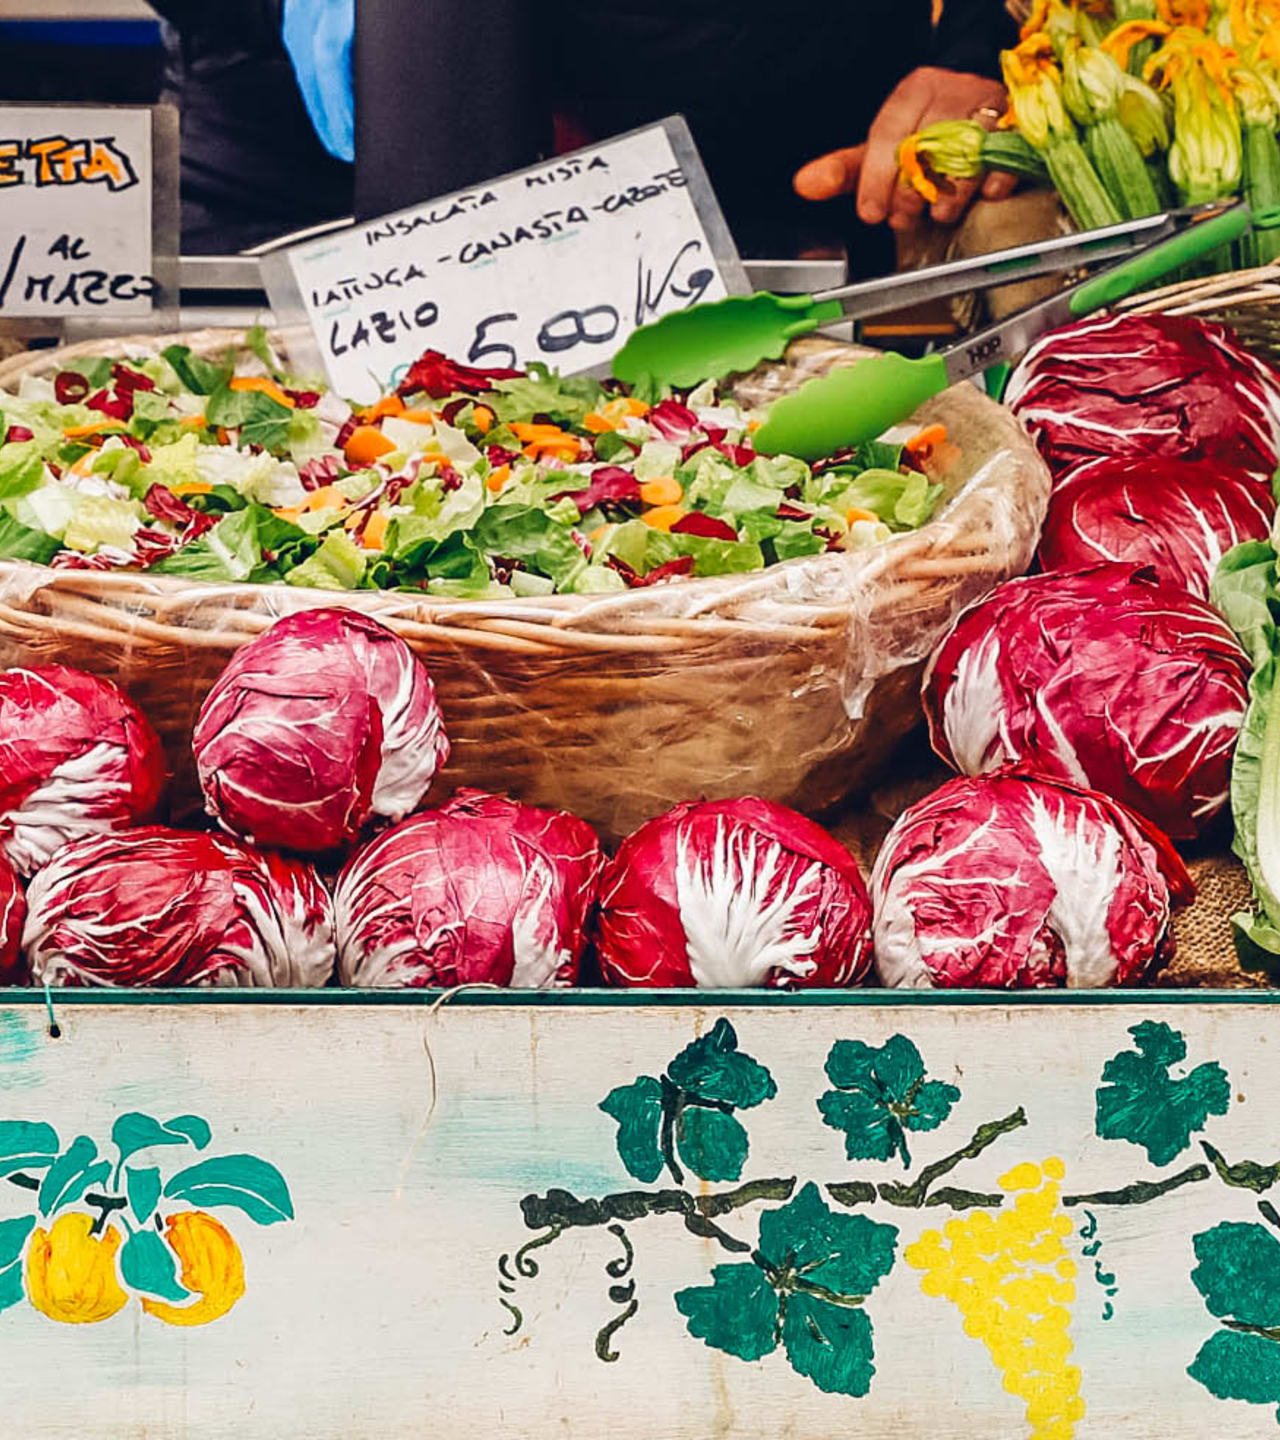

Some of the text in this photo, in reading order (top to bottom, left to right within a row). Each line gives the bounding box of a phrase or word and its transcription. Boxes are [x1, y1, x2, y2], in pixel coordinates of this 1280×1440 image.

[365, 156, 611, 247] INSALATA MISTA
[330, 301, 439, 358] LAZIO
